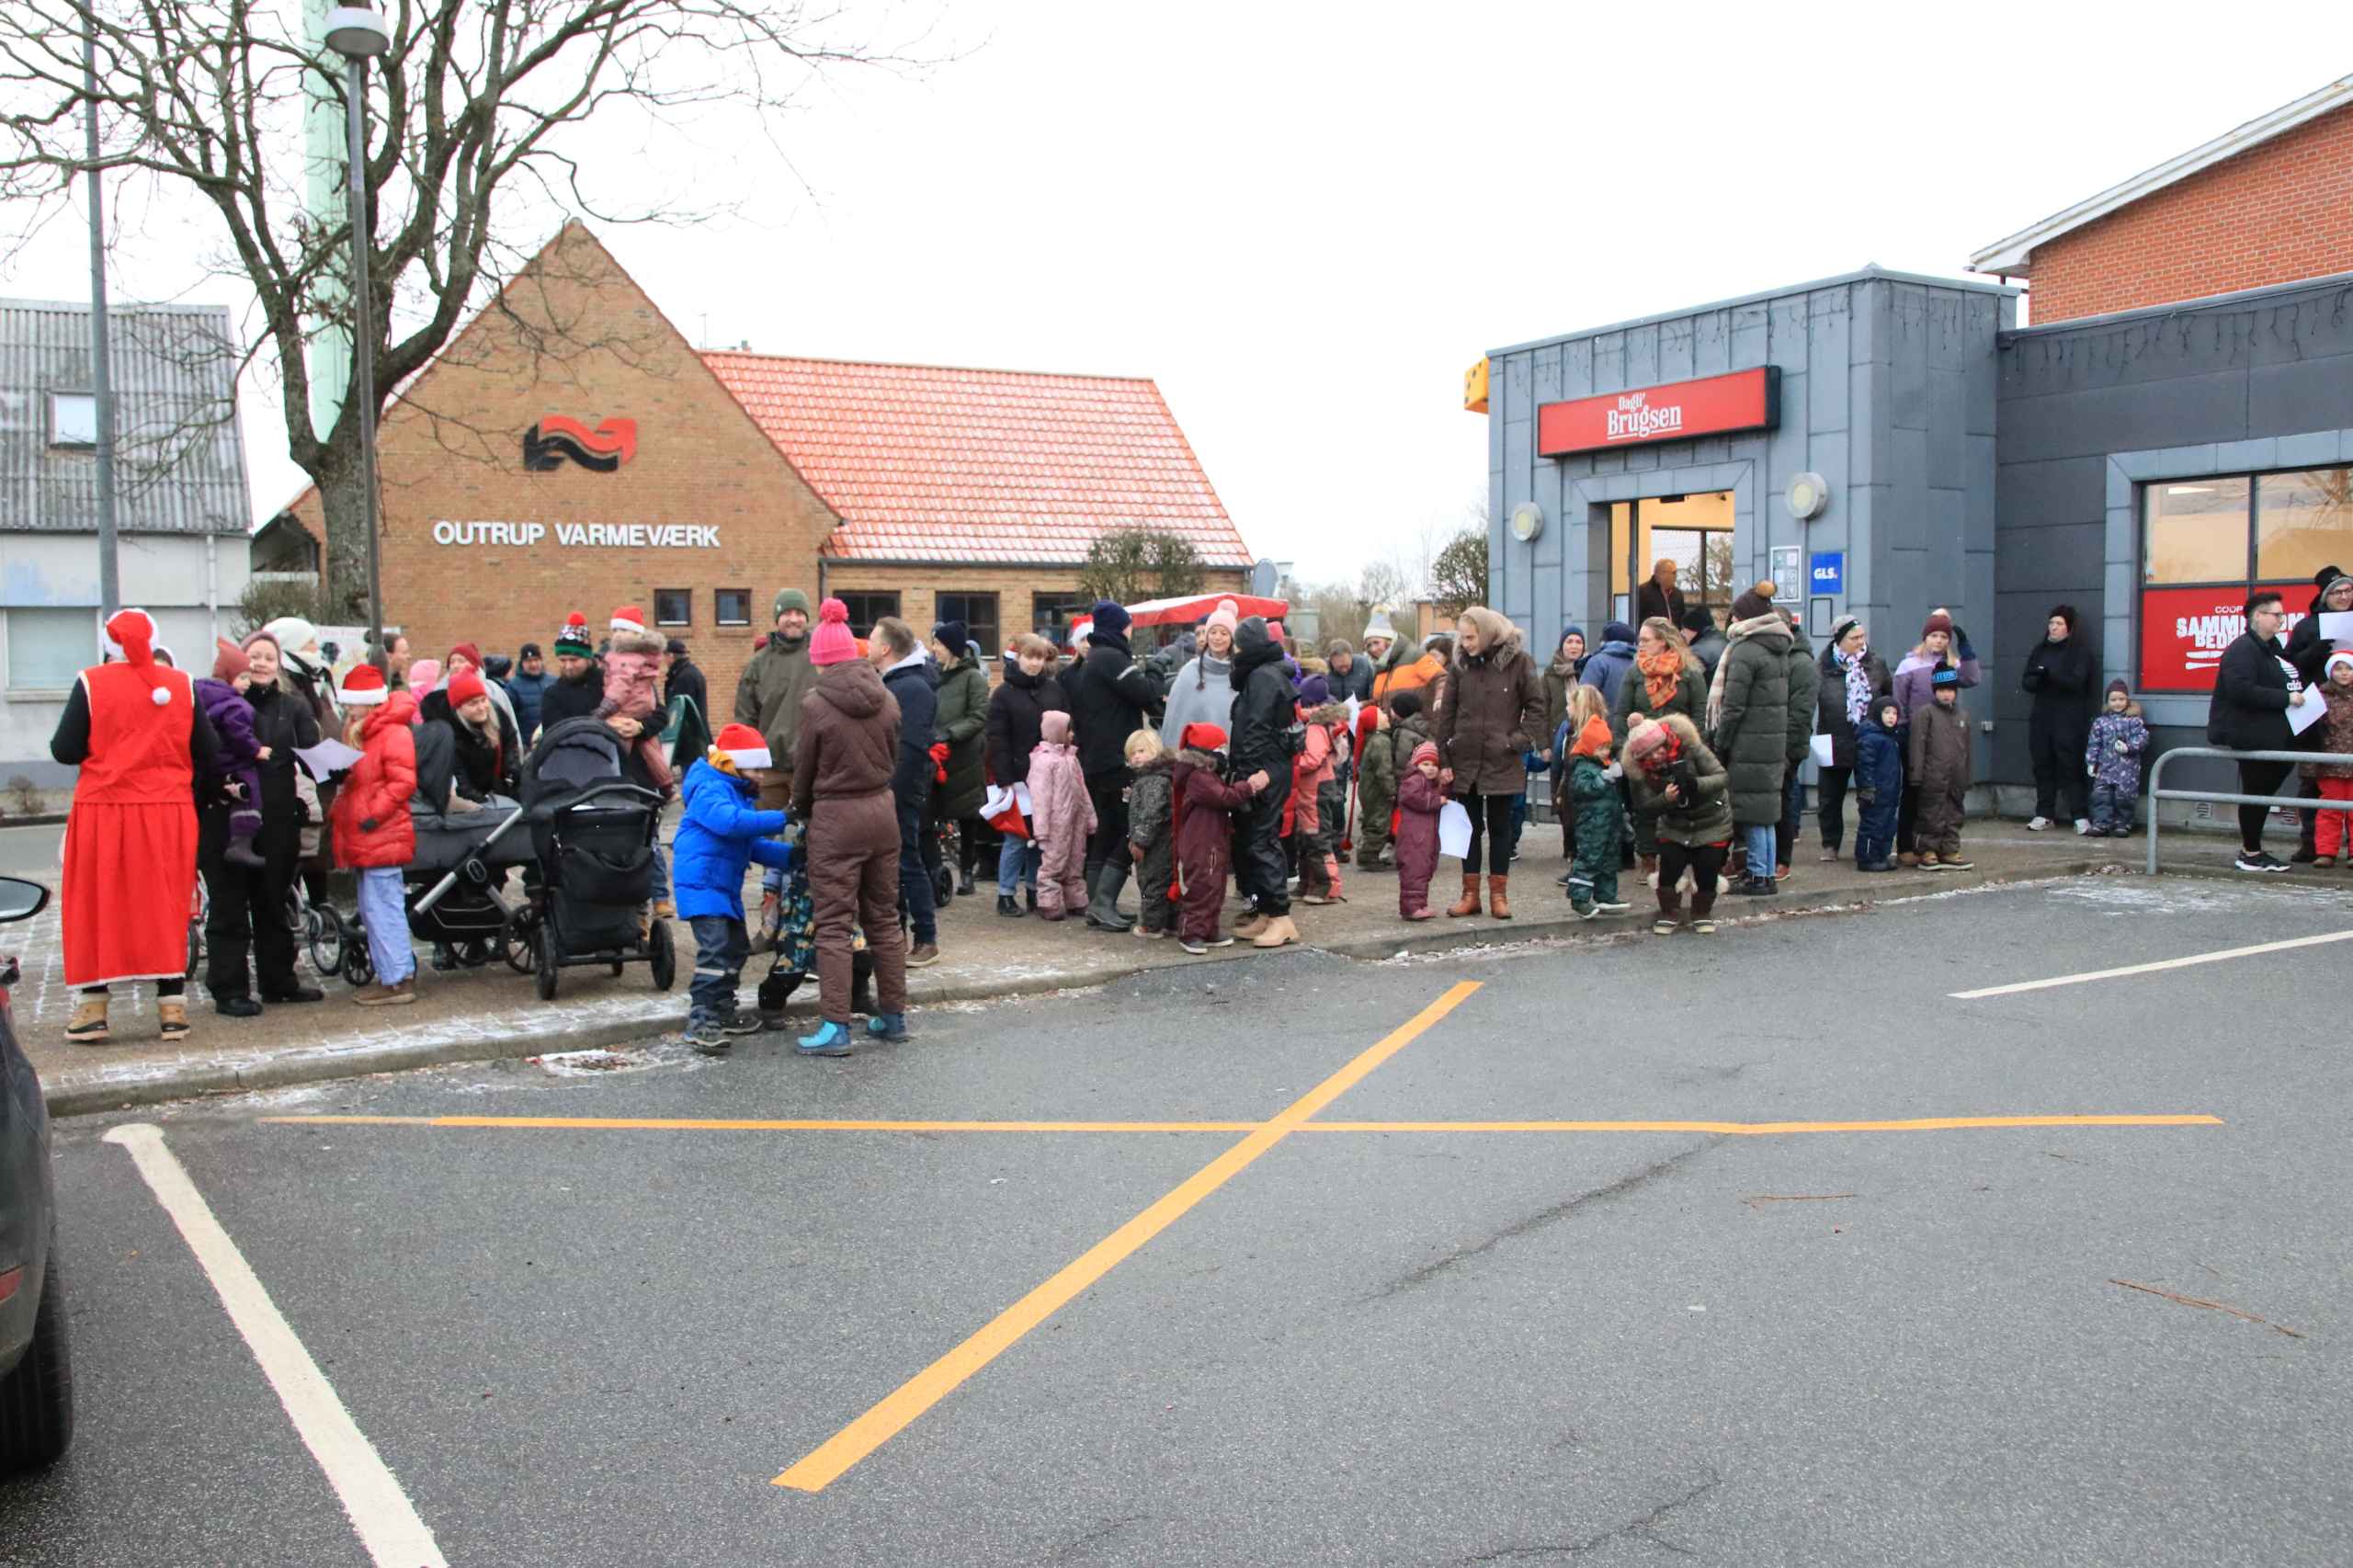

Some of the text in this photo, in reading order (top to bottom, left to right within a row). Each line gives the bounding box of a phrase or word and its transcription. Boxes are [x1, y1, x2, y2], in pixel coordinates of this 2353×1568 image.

[1607, 404, 1681, 438] Brugsen
[433, 520, 722, 548] OUTRUP VARMEVÆRK
